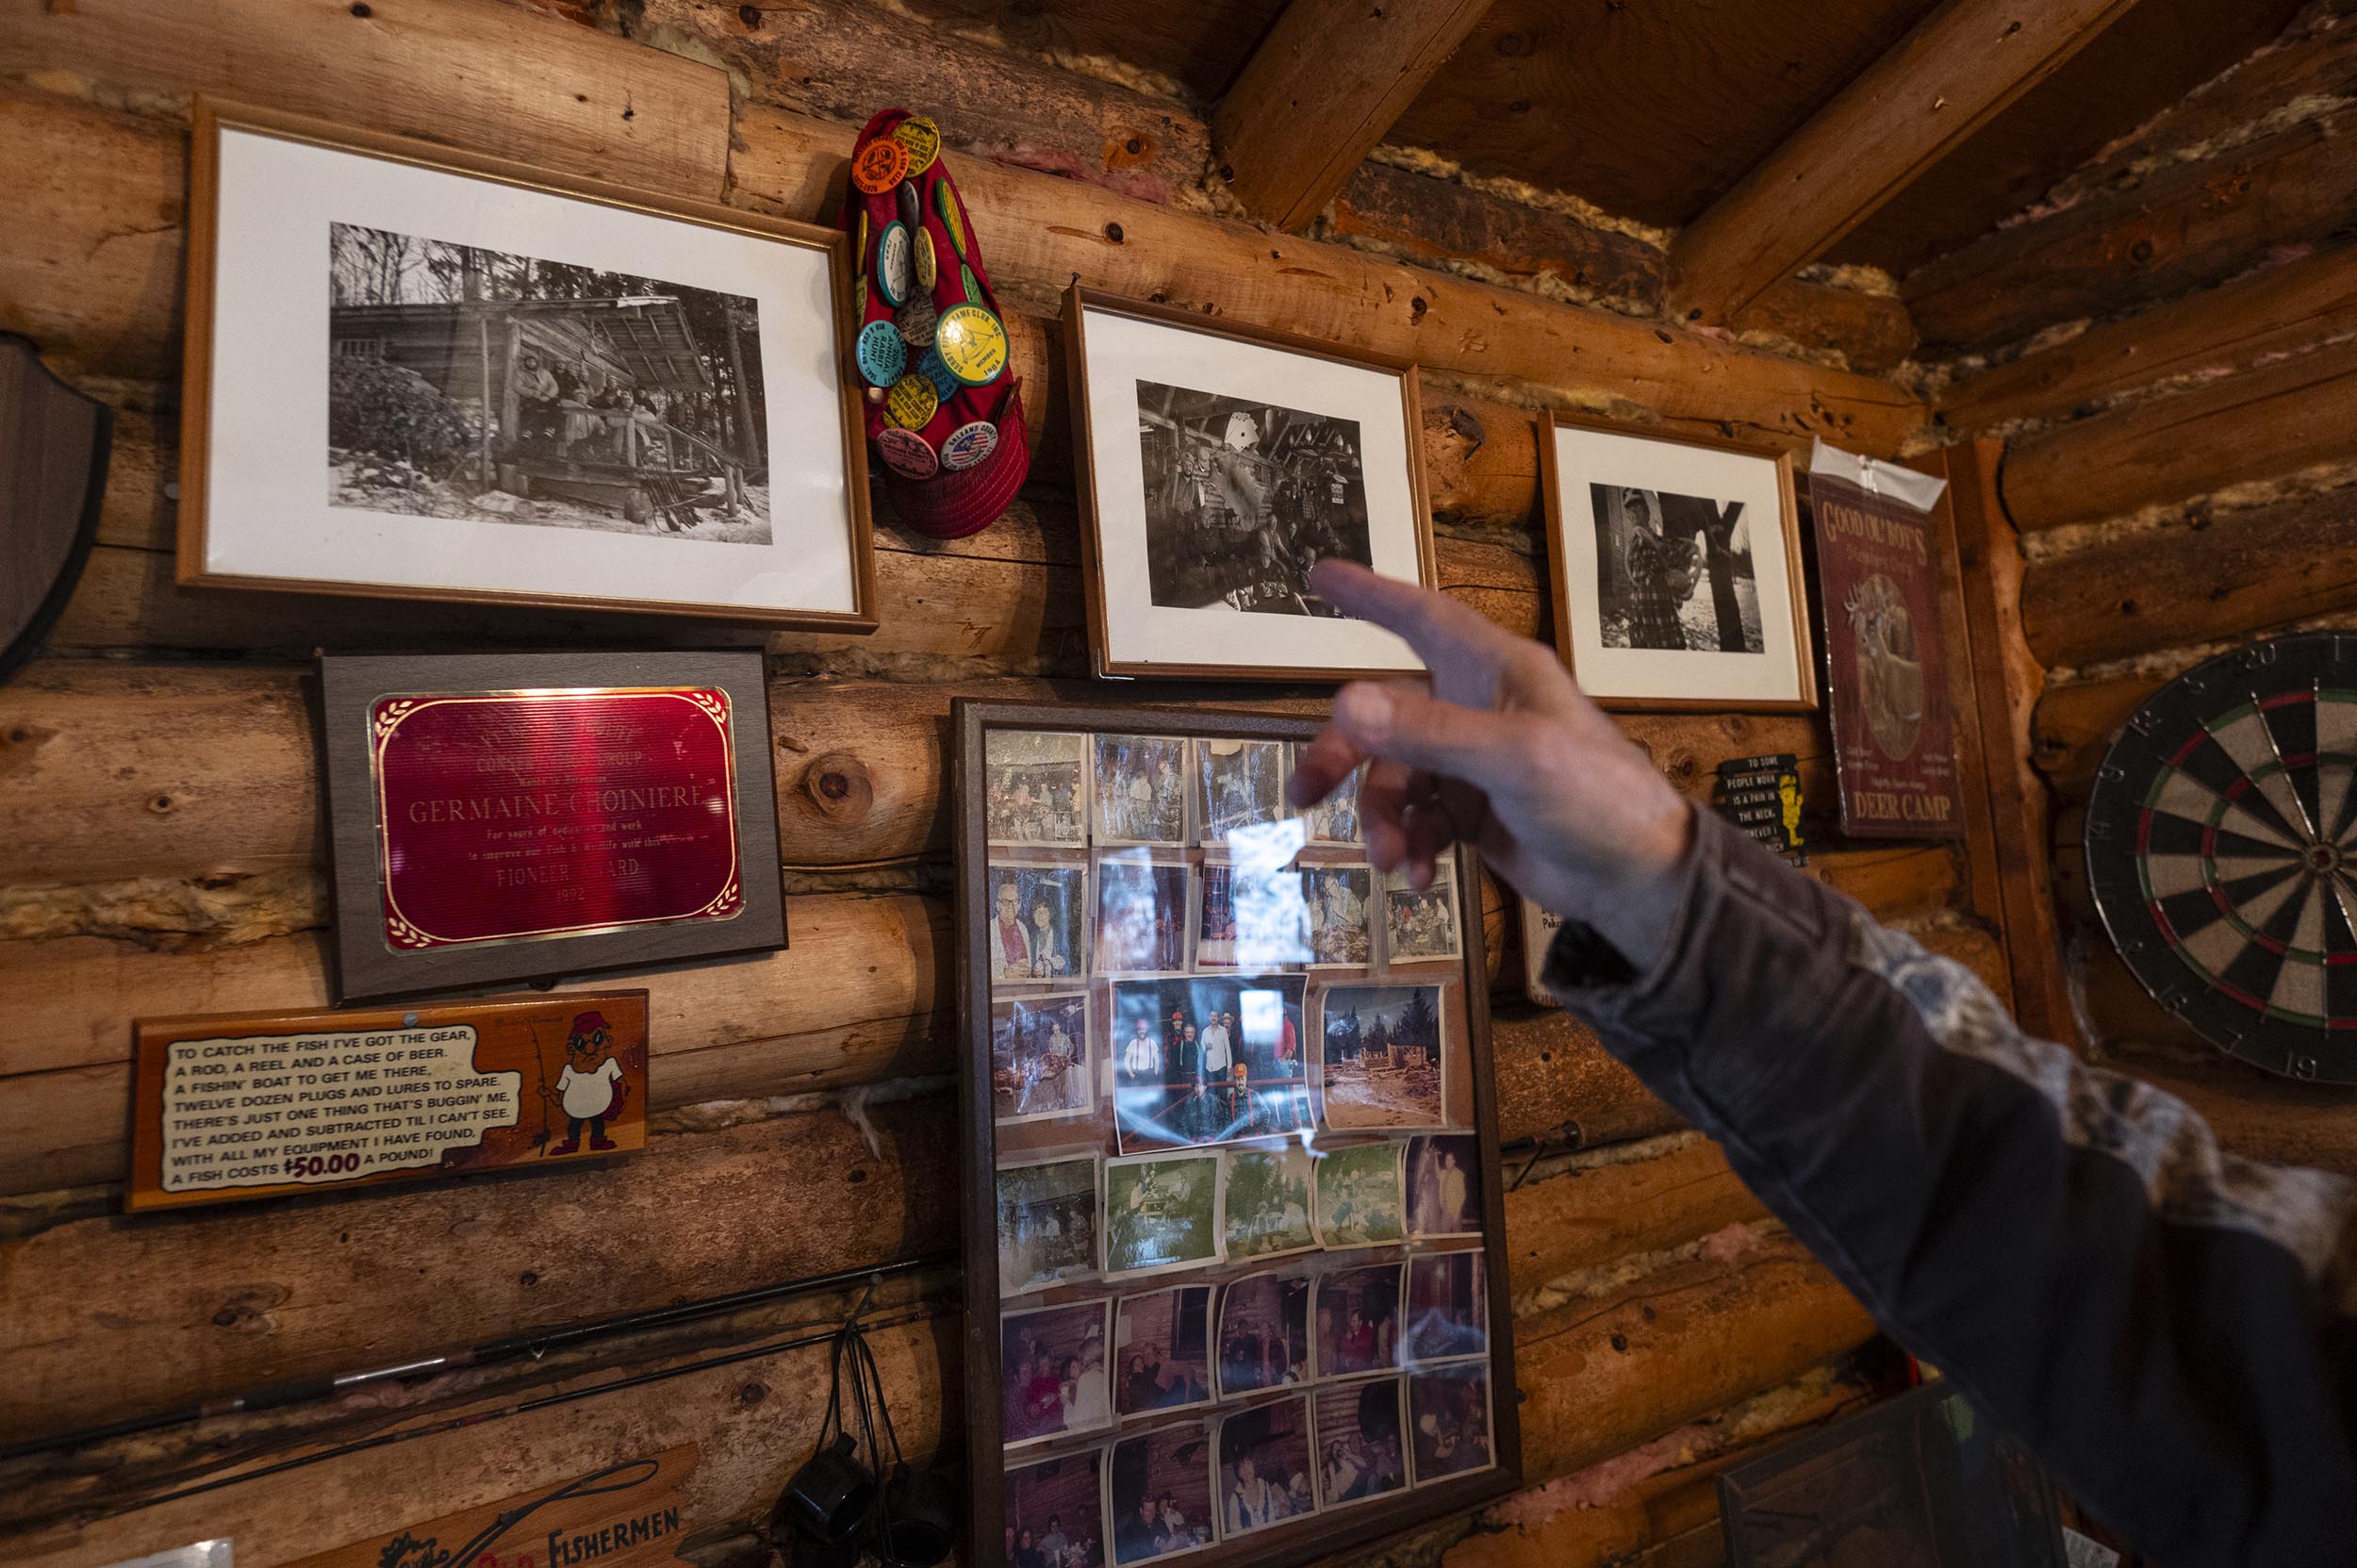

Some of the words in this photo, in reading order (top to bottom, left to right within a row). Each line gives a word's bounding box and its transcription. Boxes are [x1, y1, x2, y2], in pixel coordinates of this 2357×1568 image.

[869, 336, 880, 363] HUNT
[875, 336, 887, 368] RABBIT
[882, 336, 893, 374] ANNUAL
[975, 347, 997, 369] MEMBER
[947, 424, 980, 446] ORLEANS
[979, 422, 996, 440] COUNTY
[1822, 501, 1864, 543] GOOD
[1748, 758, 1758, 767] TO
[1760, 756, 1778, 767] SOME
[1727, 777, 1754, 789] PEOPLE
[1756, 774, 1776, 784] WORK
[409, 793, 561, 823] GERMAINE
[1733, 796, 1741, 806] IS
[1743, 796, 1749, 804] A
[1750, 792, 1766, 803] PAIN
[1768, 791, 1775, 801] IN
[1854, 791, 1902, 819] DEER
[1902, 794, 1952, 821] CAMP
[486, 829, 507, 840] For
[537, 825, 547, 837] of
[621, 819, 643, 831] work
[1739, 812, 1753, 822] THE
[468, 850, 479, 861] to
[546, 844, 567, 856] Fish
[584, 839, 618, 852] Wildlife
[621, 837, 643, 850] with
[497, 864, 569, 887] PIONEER
[556, 888, 585, 902] 1992
[177, 1048, 197, 1060] TO
[202, 1044, 255, 1058] CATCH
[260, 1042, 289, 1054] THE
[295, 1039, 329, 1052] FISH
[365, 1035, 395, 1047] GOT
[400, 1032, 426, 1045] THE
[174, 1066, 187, 1078] A
[233, 1063, 246, 1073] A
[249, 1059, 287, 1072] REEL
[290, 1057, 324, 1069] AND
[327, 1055, 340, 1066] A
[342, 1052, 381, 1065] CASE
[385, 1050, 405, 1062] OF
[2285, 1048, 2317, 1081] 19
[173, 1084, 187, 1095] A
[252, 1076, 291, 1089] BOAT
[297, 1074, 318, 1086] TO
[321, 1071, 351, 1083] GET
[354, 1069, 377, 1081] ME
[174, 1098, 236, 1114] TWELVE
[240, 1093, 293, 1108] DOZEN
[298, 1089, 347, 1103] PLUGS
[350, 1086, 383, 1098] AND
[387, 1081, 431, 1096] LURES
[434, 1081, 453, 1091] TO
[242, 1111, 282, 1125] JUST
[287, 1108, 319, 1121] ONE
[323, 1104, 370, 1117] THING
[206, 1131, 263, 1147] ADDED
[266, 1128, 302, 1141] AND
[305, 1117, 402, 1137] SUBTRACTED
[405, 1115, 426, 1127] TIL
[429, 1115, 435, 1125] I
[171, 1153, 214, 1167] WITH
[219, 1150, 247, 1163] ALL
[253, 1146, 278, 1159] MY
[282, 1137, 370, 1156] EQUIPMENT
[372, 1136, 379, 1147] I
[384, 1132, 420, 1147] HAVE
[171, 1173, 184, 1184] A
[189, 1169, 223, 1183] FISH
[227, 1164, 278, 1180] COSTS
[363, 1153, 375, 1164] A
[548, 1506, 680, 1568] FISHERMEN
